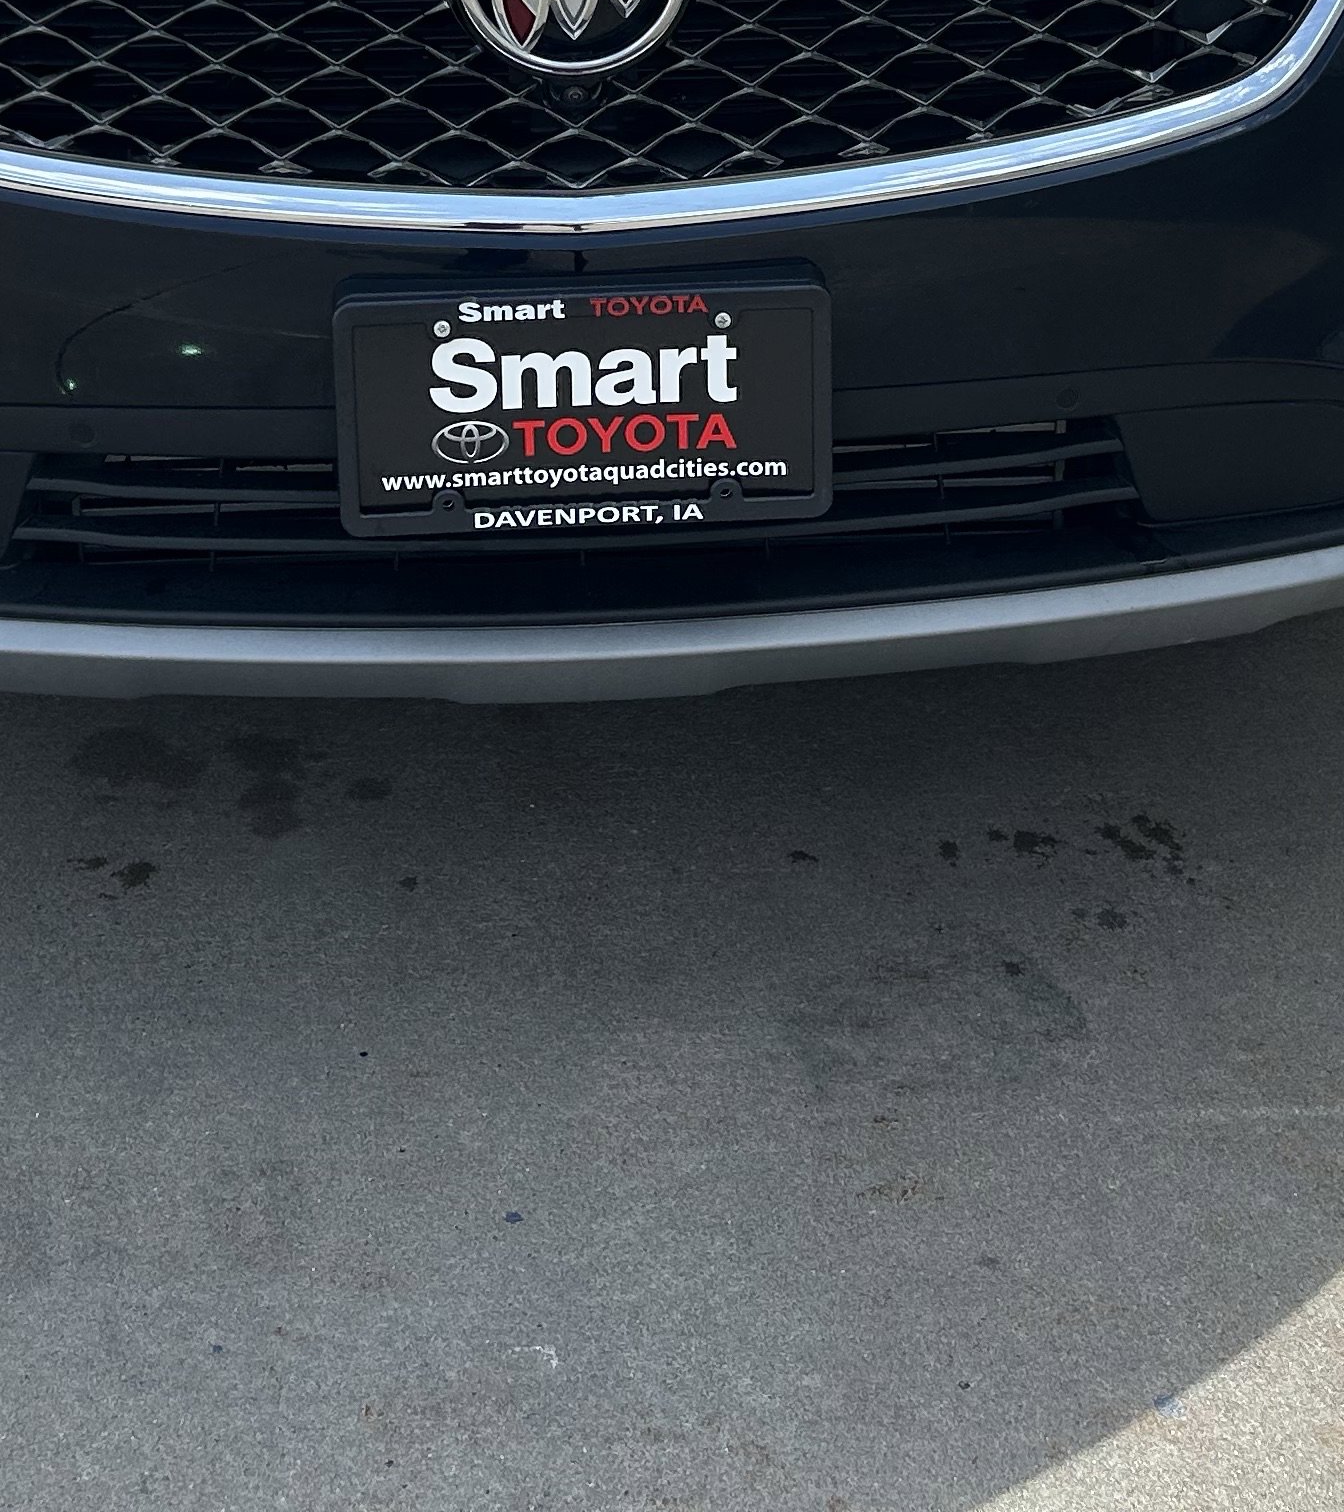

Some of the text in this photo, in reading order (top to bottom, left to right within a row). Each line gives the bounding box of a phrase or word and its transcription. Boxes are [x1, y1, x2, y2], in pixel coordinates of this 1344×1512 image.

[458, 294, 709, 324] Smart TOYOTA
[429, 334, 738, 414] Smart
[512, 412, 738, 457] TOYOTA
[381, 458, 788, 492] www.smarttoyotaquadcities.com
[473, 503, 704, 529] DAVENPORT, IA
